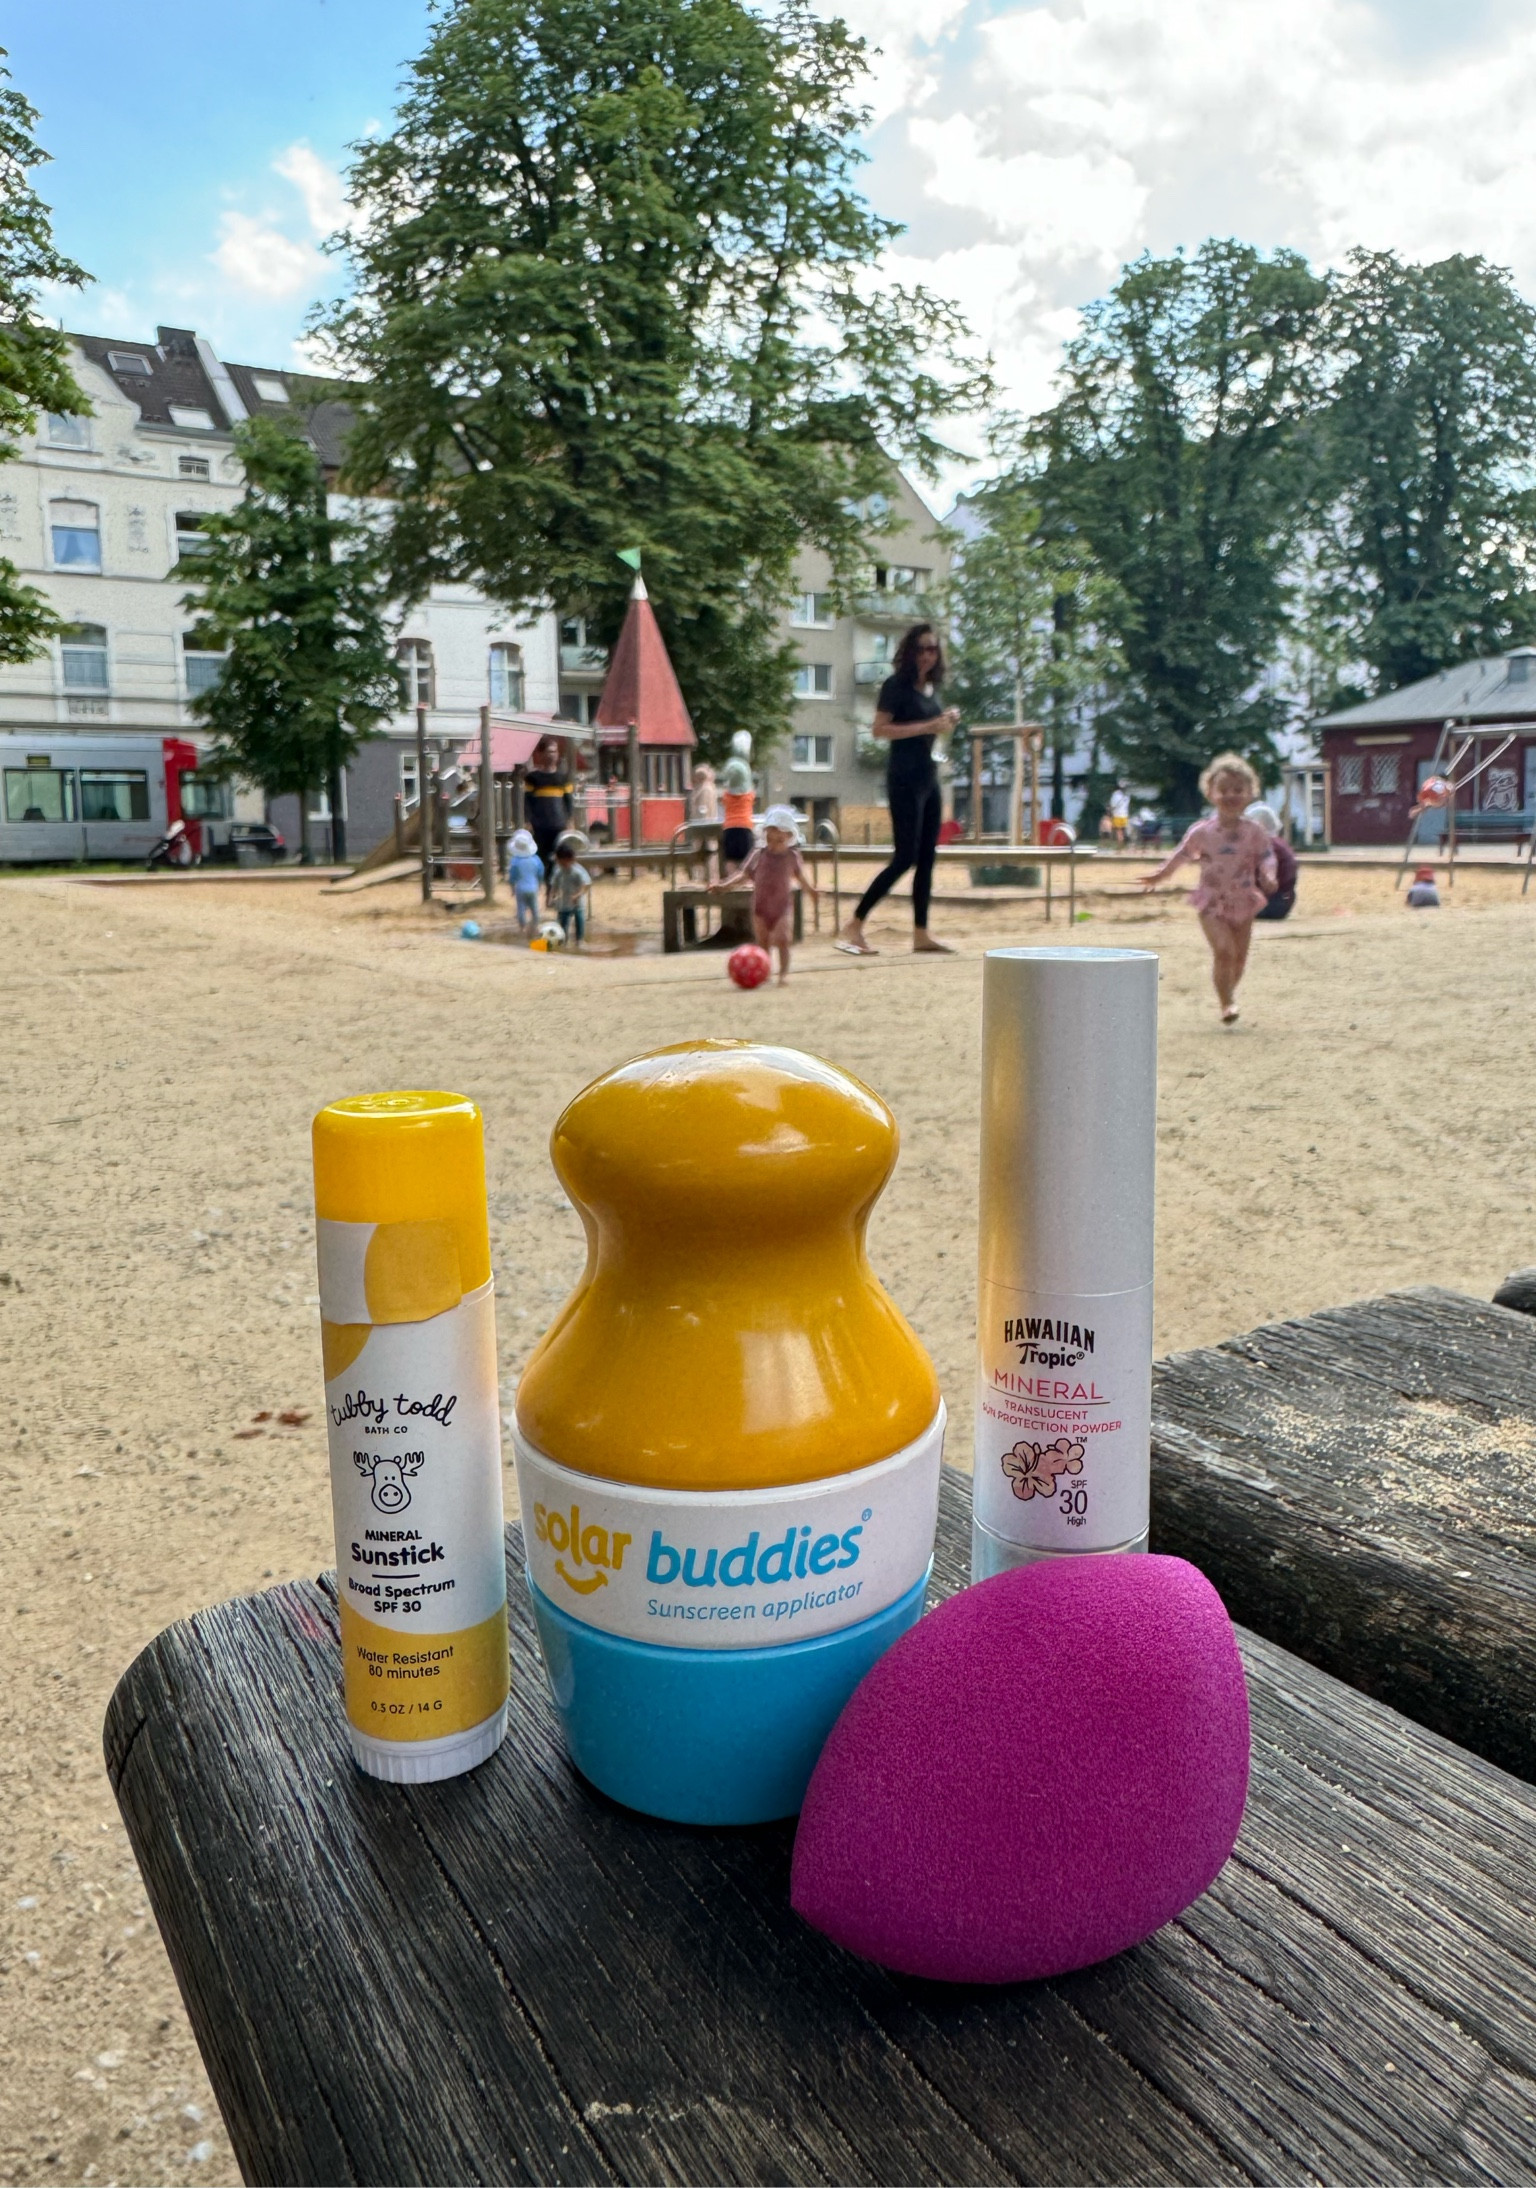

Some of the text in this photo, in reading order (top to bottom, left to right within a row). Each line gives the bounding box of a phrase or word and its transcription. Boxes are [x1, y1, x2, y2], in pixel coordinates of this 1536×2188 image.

[1004, 1317, 1095, 1354] HAWAIIAN
[994, 1368, 1104, 1400] MINERAL
[330, 1390, 457, 1427] tubby todd
[1004, 1399, 1088, 1421] TRANSLUCENT
[364, 1426, 408, 1434] BATH CO
[998, 1411, 1068, 1433] PROTECTION
[1072, 1420, 1122, 1434] POWDER
[1071, 1479, 1088, 1489] SPF
[1059, 1489, 1088, 1515] 30
[1067, 1516, 1087, 1527] High
[364, 1530, 422, 1542] MINERAL
[533, 1501, 632, 1570] solar
[351, 1542, 445, 1567] Sunstick
[348, 1578, 455, 1601] Broad Spectrum
[374, 1600, 421, 1613] SPF 30
[647, 1580, 864, 1622] Sunscreen applicator
[356, 1645, 454, 1664] Water Resistant
[368, 1664, 440, 1679] 80 minutes
[389, 1704, 405, 1714] OZ
[418, 1702, 430, 1713] 14
[433, 1700, 443, 1711] G
